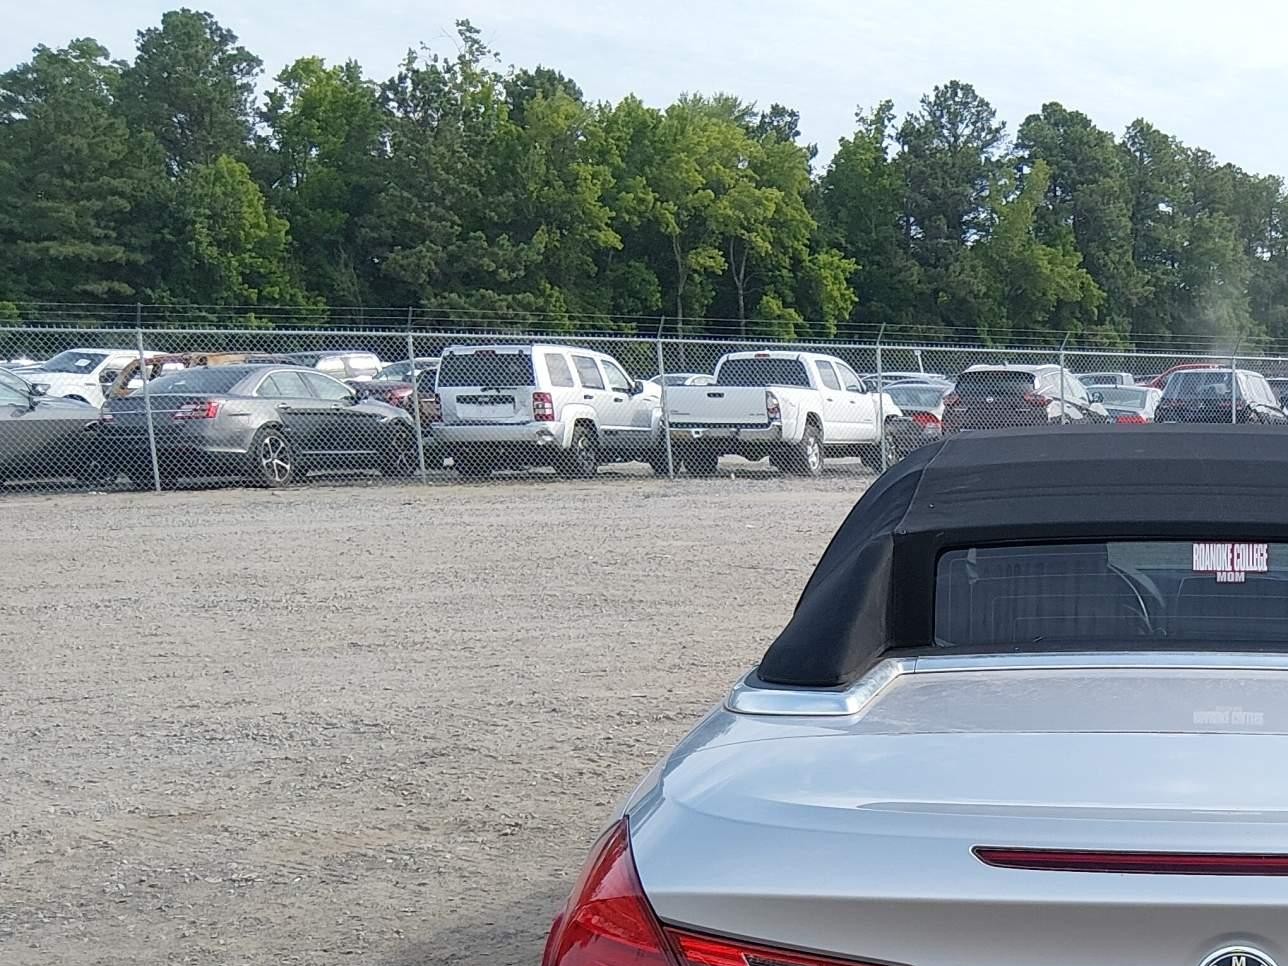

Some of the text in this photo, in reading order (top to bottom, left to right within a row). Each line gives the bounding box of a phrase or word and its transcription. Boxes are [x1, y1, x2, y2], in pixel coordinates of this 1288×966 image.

[1192, 543, 1268, 571] ROANOKE COLLEGE
[1216, 571, 1245, 583] MOM
